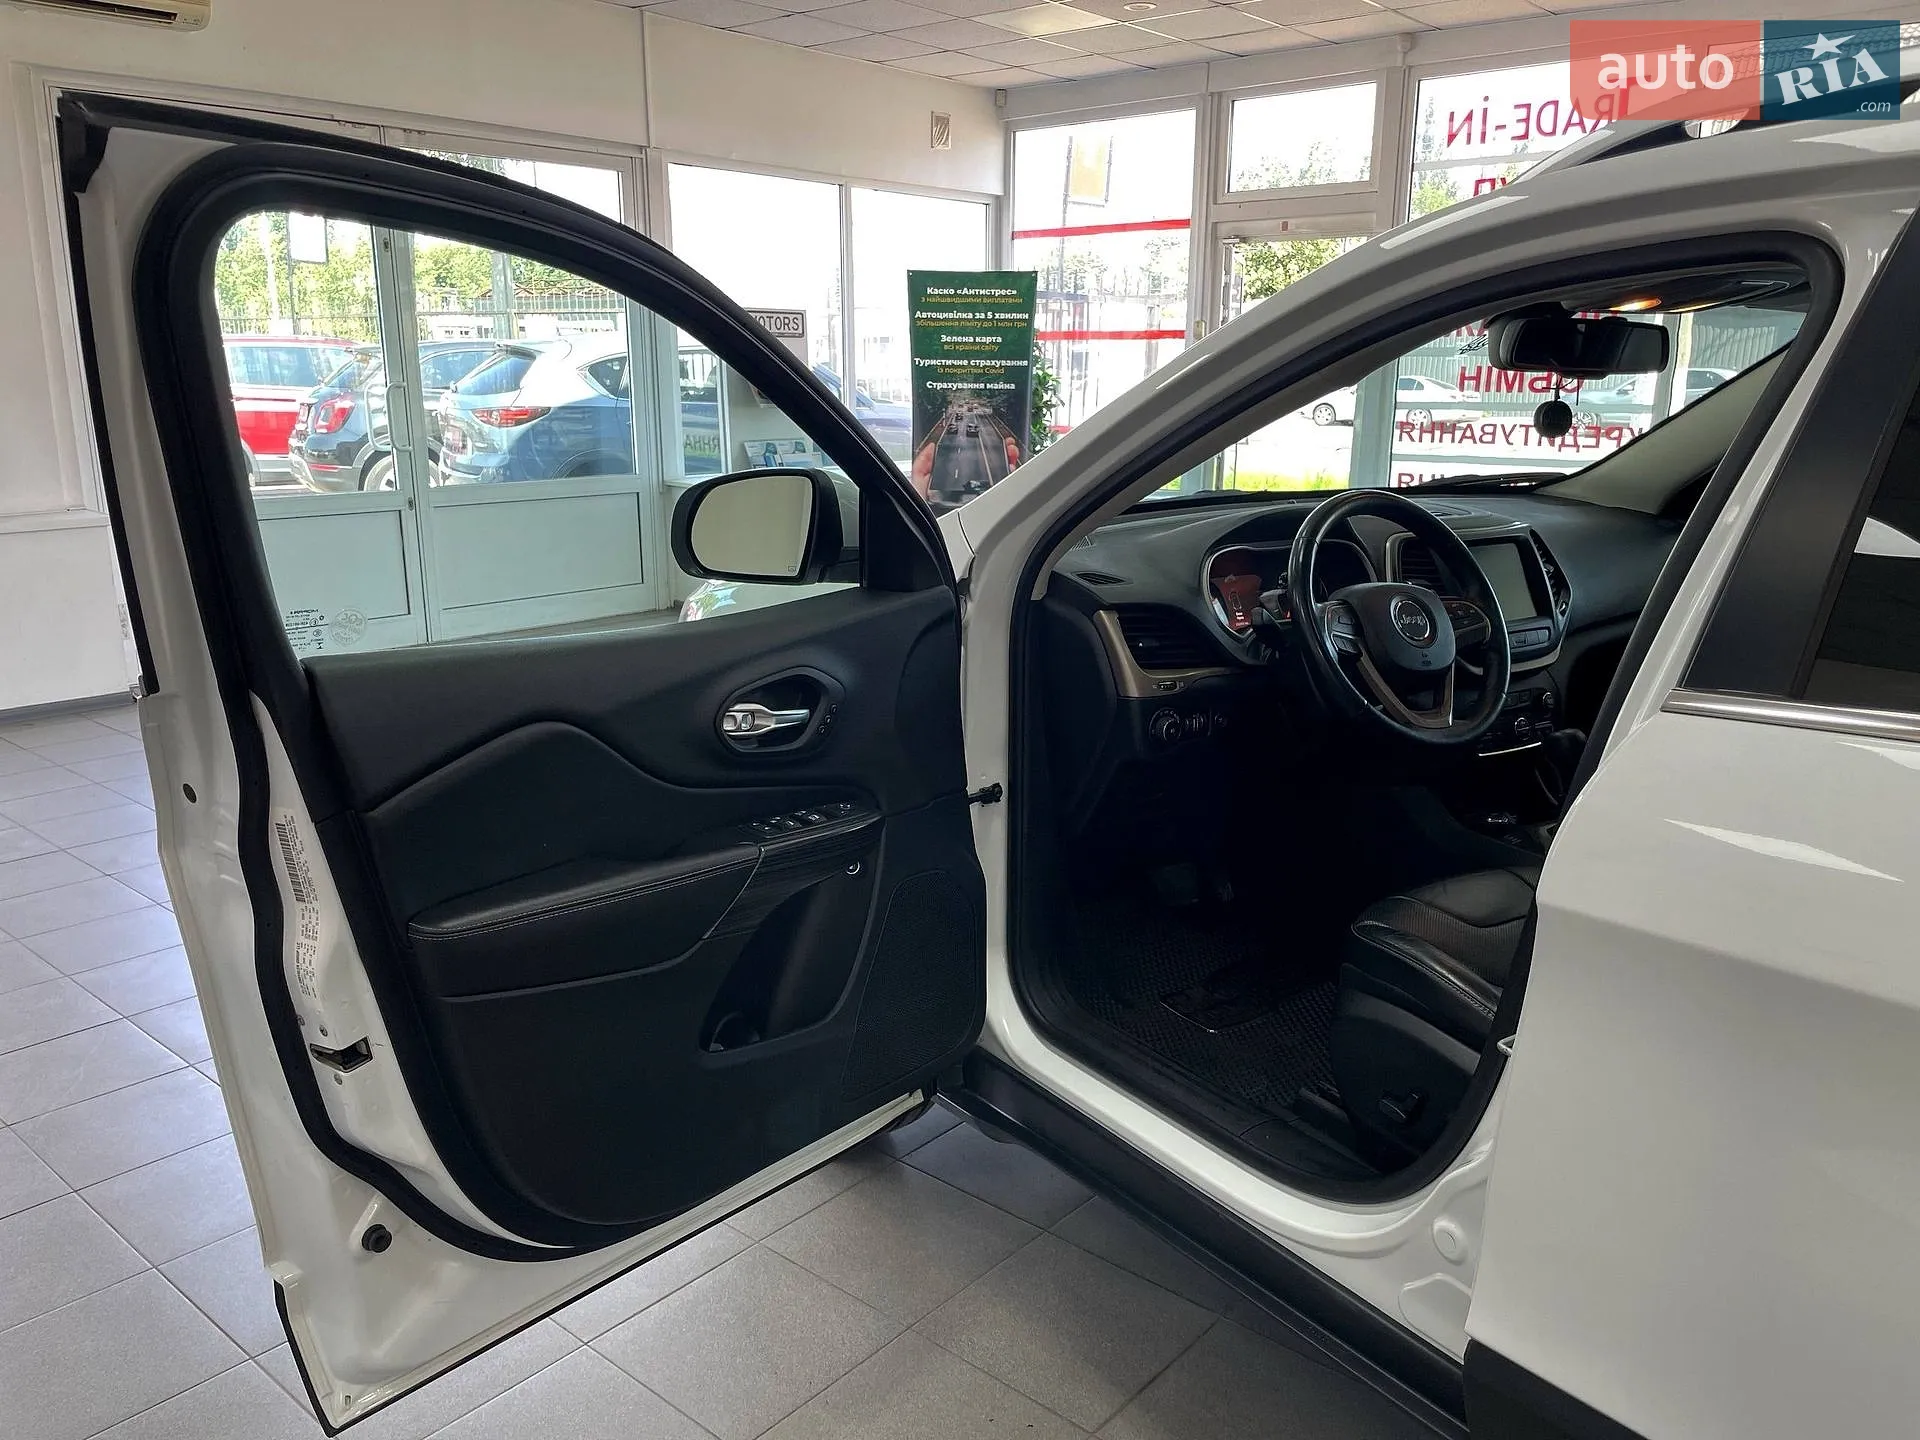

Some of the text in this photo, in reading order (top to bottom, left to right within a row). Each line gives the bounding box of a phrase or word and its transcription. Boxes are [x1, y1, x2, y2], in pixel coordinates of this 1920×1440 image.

[926, 287, 1018, 297] Каско «Антистрес»
[914, 310, 973, 320] Автоцивілка
[755, 316, 800, 331] OTORS
[940, 334, 1002, 344] Зелена карта
[981, 344, 1000, 352] світу
[914, 358, 1028, 368] Туристичне страхування
[926, 381, 1016, 390] Страхування майна
